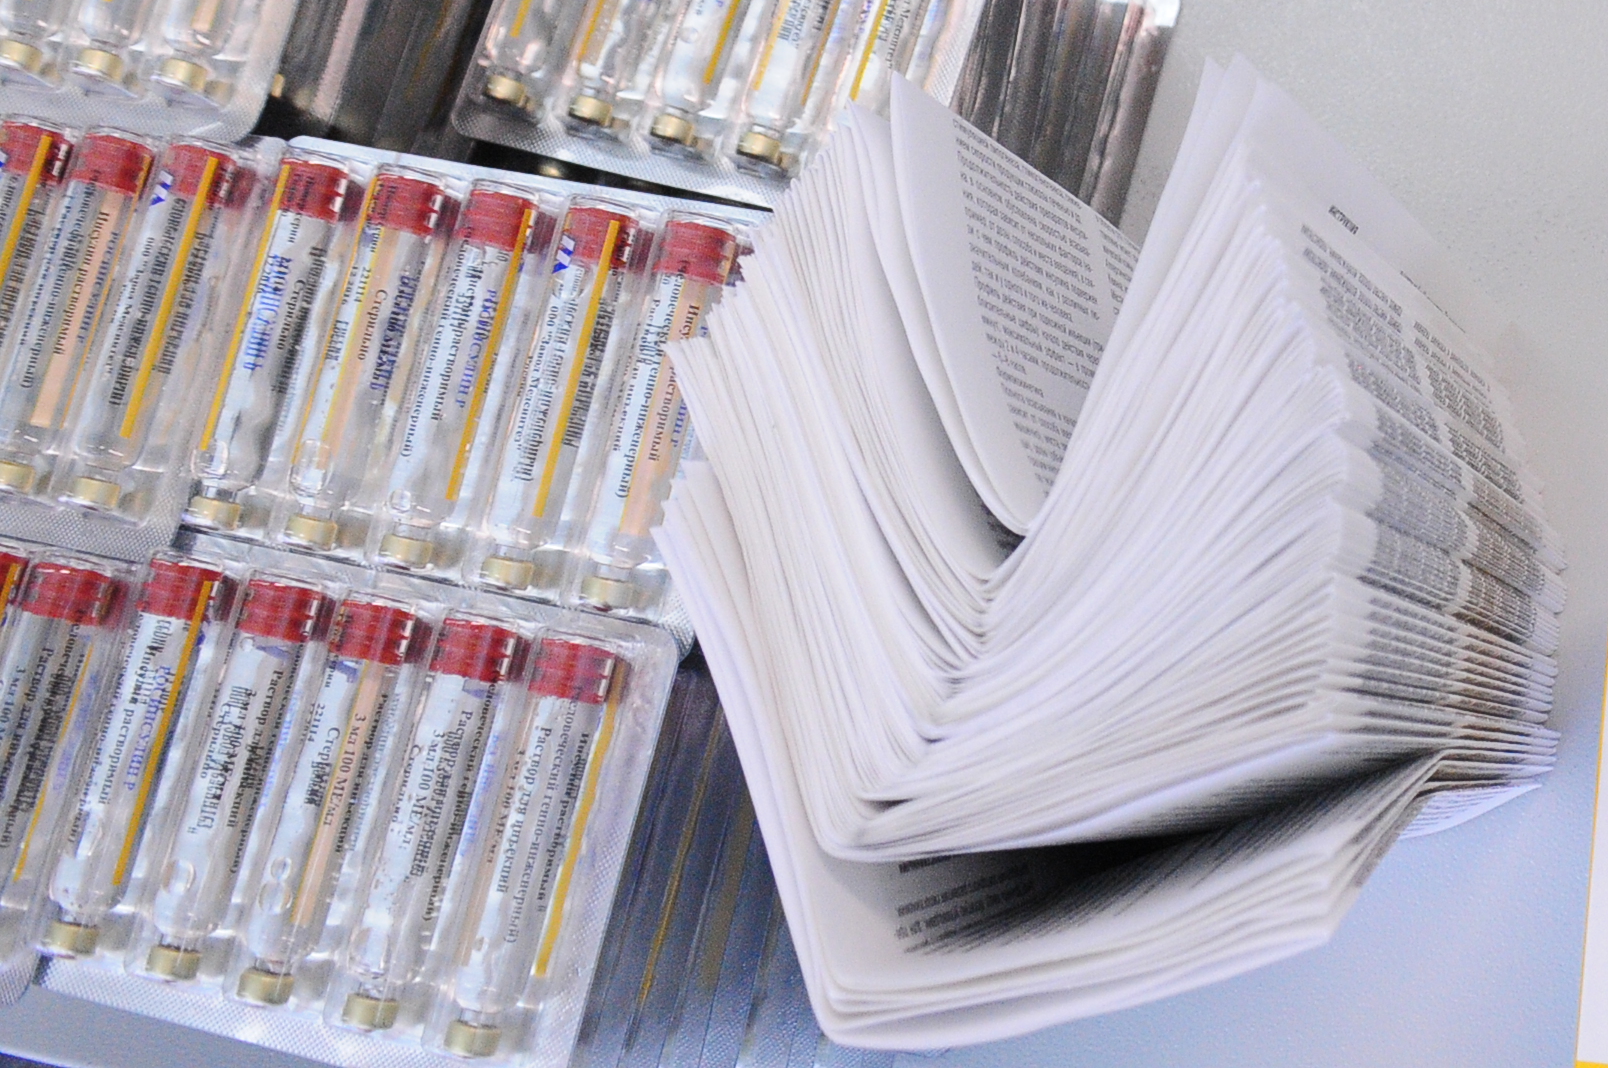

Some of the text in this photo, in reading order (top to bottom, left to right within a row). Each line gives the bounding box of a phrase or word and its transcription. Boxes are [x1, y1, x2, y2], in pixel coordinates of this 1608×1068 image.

[356, 288, 388, 361] Стерильно
[338, 749, 355, 774] 100
[521, 726, 552, 785] Раствор
[417, 766, 435, 790] 100
